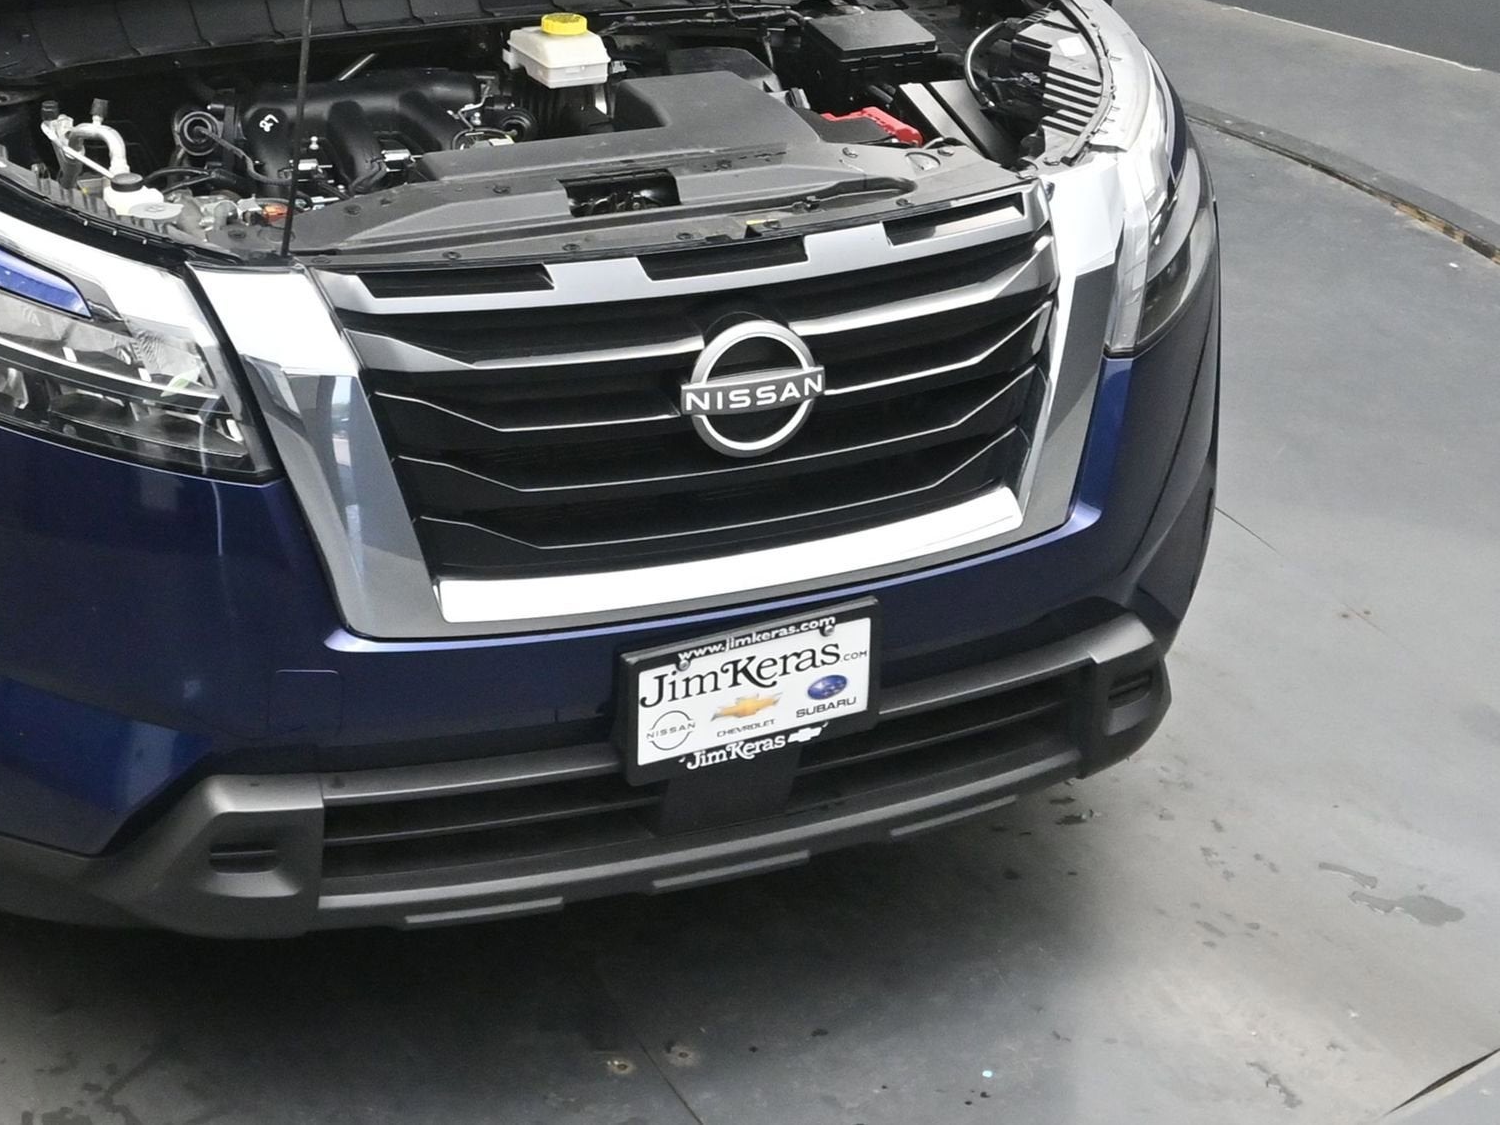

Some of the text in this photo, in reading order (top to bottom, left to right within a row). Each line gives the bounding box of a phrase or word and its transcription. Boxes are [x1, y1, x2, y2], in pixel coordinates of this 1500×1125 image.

[685, 373, 823, 411] NISSAN
[677, 616, 836, 661] www.jimkeras.com
[796, 696, 857, 719] SUBARU
[646, 721, 696, 740] NISSAN
[716, 718, 776, 738] CHEVROLET
